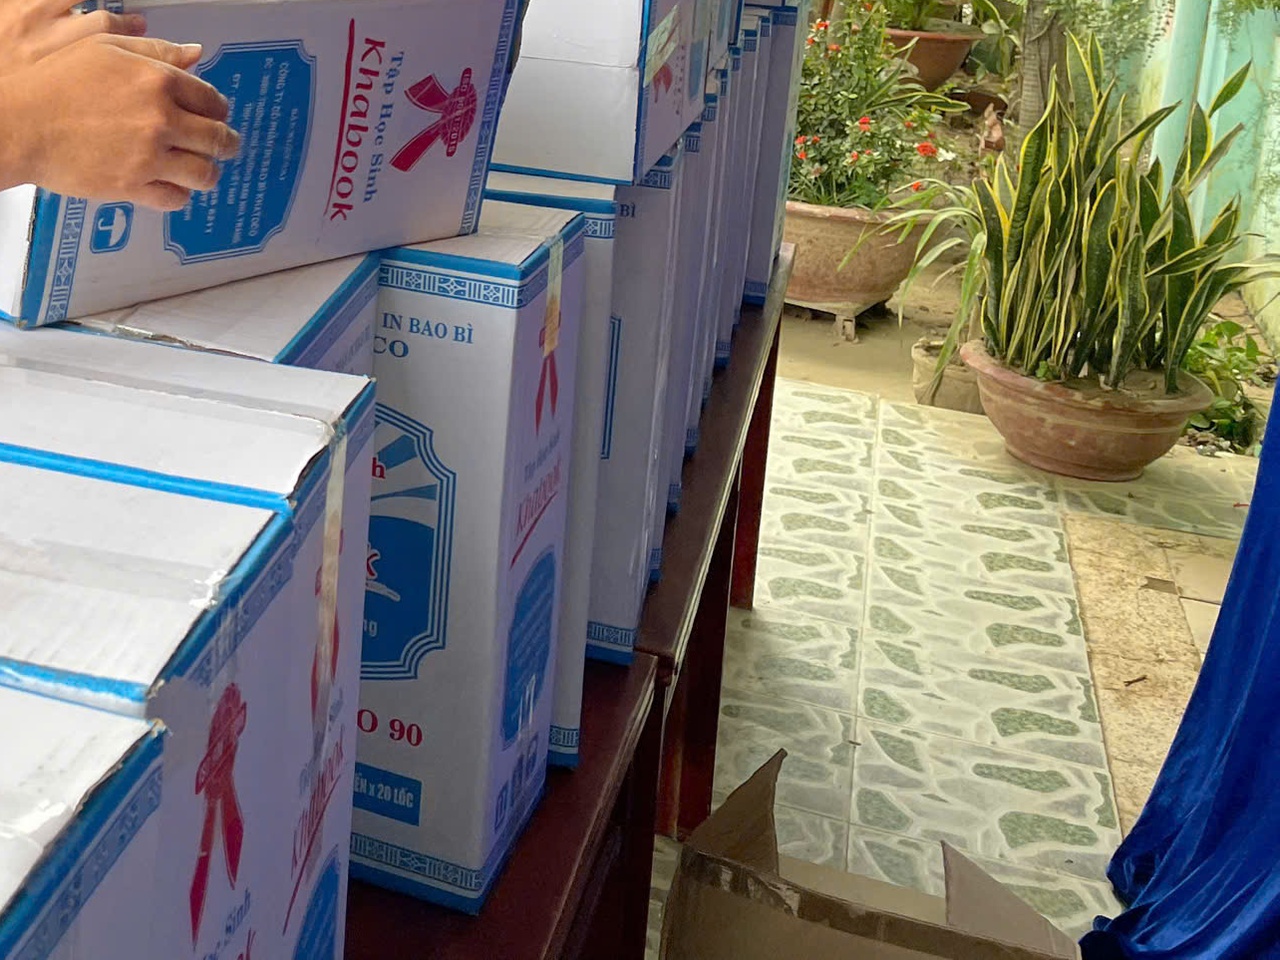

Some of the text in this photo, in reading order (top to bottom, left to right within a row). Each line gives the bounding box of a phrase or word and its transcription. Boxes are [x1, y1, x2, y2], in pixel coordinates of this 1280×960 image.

[272, 92, 283, 103] TY
[330, 37, 387, 222] Khabook
[363, 51, 405, 203] Tập Học Sinh
[382, 312, 474, 344] IN BAO BÌ
[373, 335, 409, 358] CO
[389, 718, 423, 747] 90
[377, 783, 392, 802] 20
